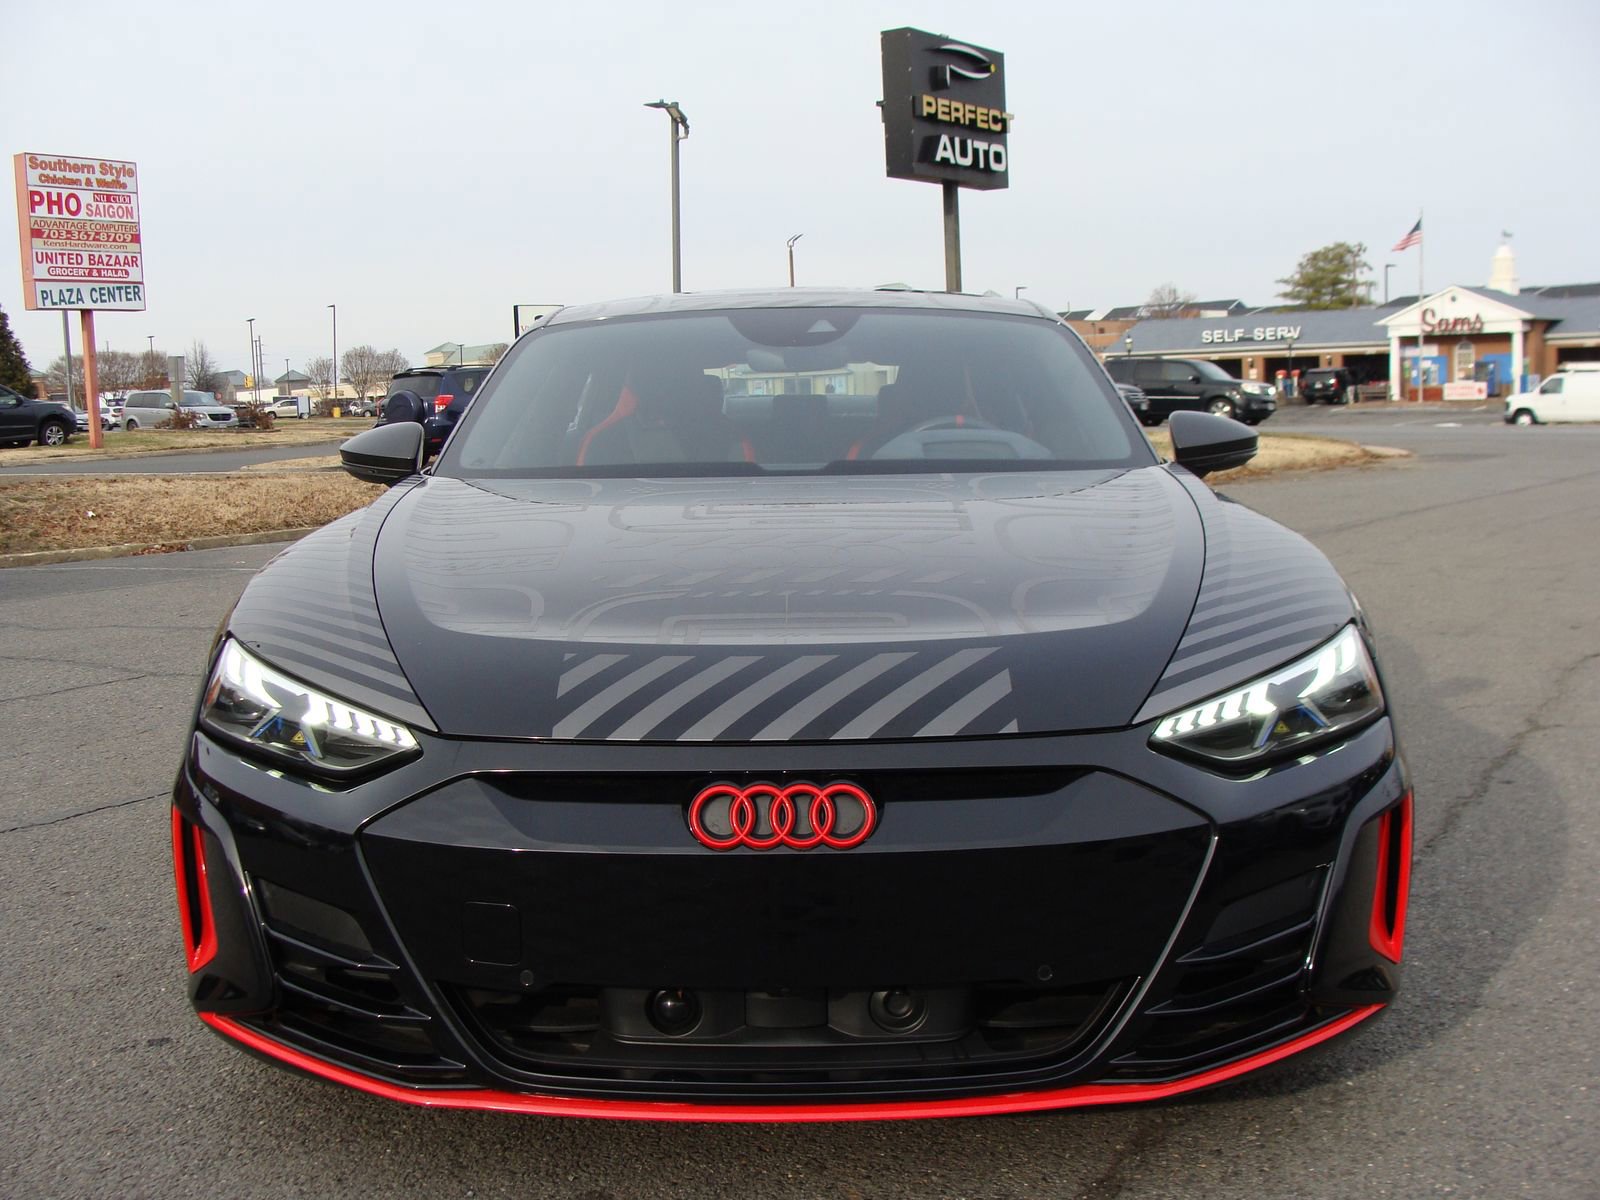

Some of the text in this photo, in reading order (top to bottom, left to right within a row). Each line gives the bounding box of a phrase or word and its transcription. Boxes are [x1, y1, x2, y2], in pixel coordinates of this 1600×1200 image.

[922, 94, 1014, 133] PERFECT
[935, 134, 1007, 172] AUTO
[29, 156, 135, 178] Southern Style
[39, 173, 128, 189] Chicken & Waffle
[30, 190, 82, 217] PHO
[86, 203, 134, 219] SAIGON
[33, 220, 138, 233] ADVANTAGE COMPUTERS
[41, 229, 132, 242] 703-367-8709
[43, 240, 128, 250] KensHardware.com
[35, 252, 139, 267] UNITED BAZAAR
[49, 267, 89, 277] GROCERY
[101, 269, 128, 278] HALAL
[41, 286, 142, 306] PLAZA CENTER
[1421, 308, 1484, 334] Sams
[1201, 326, 1301, 344] SELF SERV
